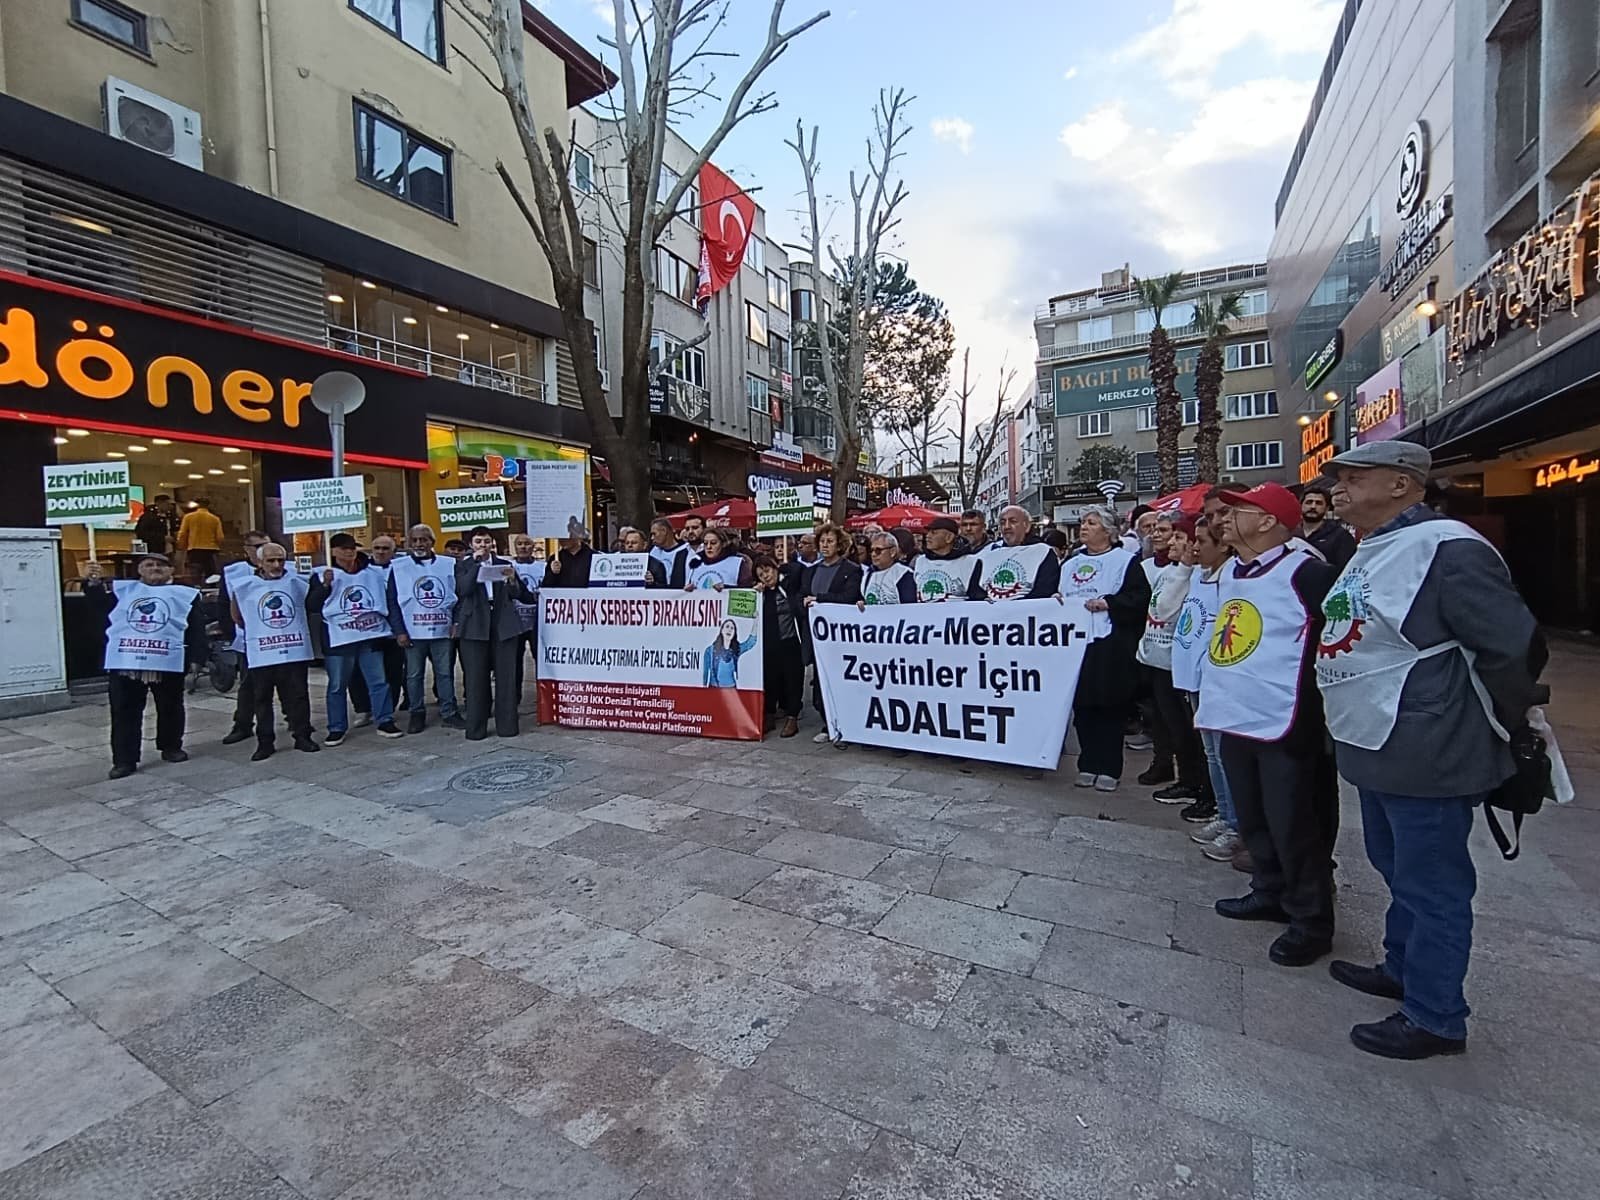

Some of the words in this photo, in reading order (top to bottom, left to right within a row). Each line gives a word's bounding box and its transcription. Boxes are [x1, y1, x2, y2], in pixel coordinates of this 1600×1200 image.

[1060, 367, 1122, 392] BAGET
[1098, 388, 1139, 402] MERKEZ
[47, 469, 126, 488] ZEYTİNİME
[302, 479, 343, 490] HAVAMA
[294, 494, 351, 507] TOPRAĞIMA
[303, 488, 343, 498] SUYUMA
[438, 492, 502, 505] TOPRAĞIMA
[768, 488, 798, 499] TORBA
[47, 493, 126, 511] DOKUNMA!
[768, 498, 800, 509] YASAYI
[286, 504, 363, 521] DOKUNMA!
[440, 509, 505, 523] DOKUNMA!
[545, 598, 574, 624] ESRA
[577, 599, 600, 632] IŞIK
[601, 600, 651, 626] SERBEST
[653, 600, 722, 627] BIRAKILSIN!
[119, 638, 170, 649] EMEKLİ
[258, 630, 303, 646] EMEKLİ
[568, 647, 640, 671] KAMULAŞTIRMA
[641, 645, 665, 668] İPTAL
[667, 646, 700, 671] EDİLSİN
[842, 654, 968, 690] Zeytinler
[979, 652, 1041, 698] İçin
[558, 682, 585, 693] Büyük
[585, 685, 624, 694] Menderes
[625, 686, 661, 697] İnisiyatifi
[605, 697, 632, 706] Denizli
[633, 699, 675, 711] Temsilciliği
[558, 704, 585, 714] Denizli
[586, 706, 614, 716] Barosu
[615, 708, 633, 717] Kent
[645, 710, 667, 720] Çevre
[668, 712, 712, 724] Komisyonu
[865, 696, 1016, 744] ADALET
[558, 715, 584, 725] Denizli
[585, 719, 608, 727] Emek
[619, 720, 661, 731] Demokrasi
[662, 722, 702, 734] Platformu
